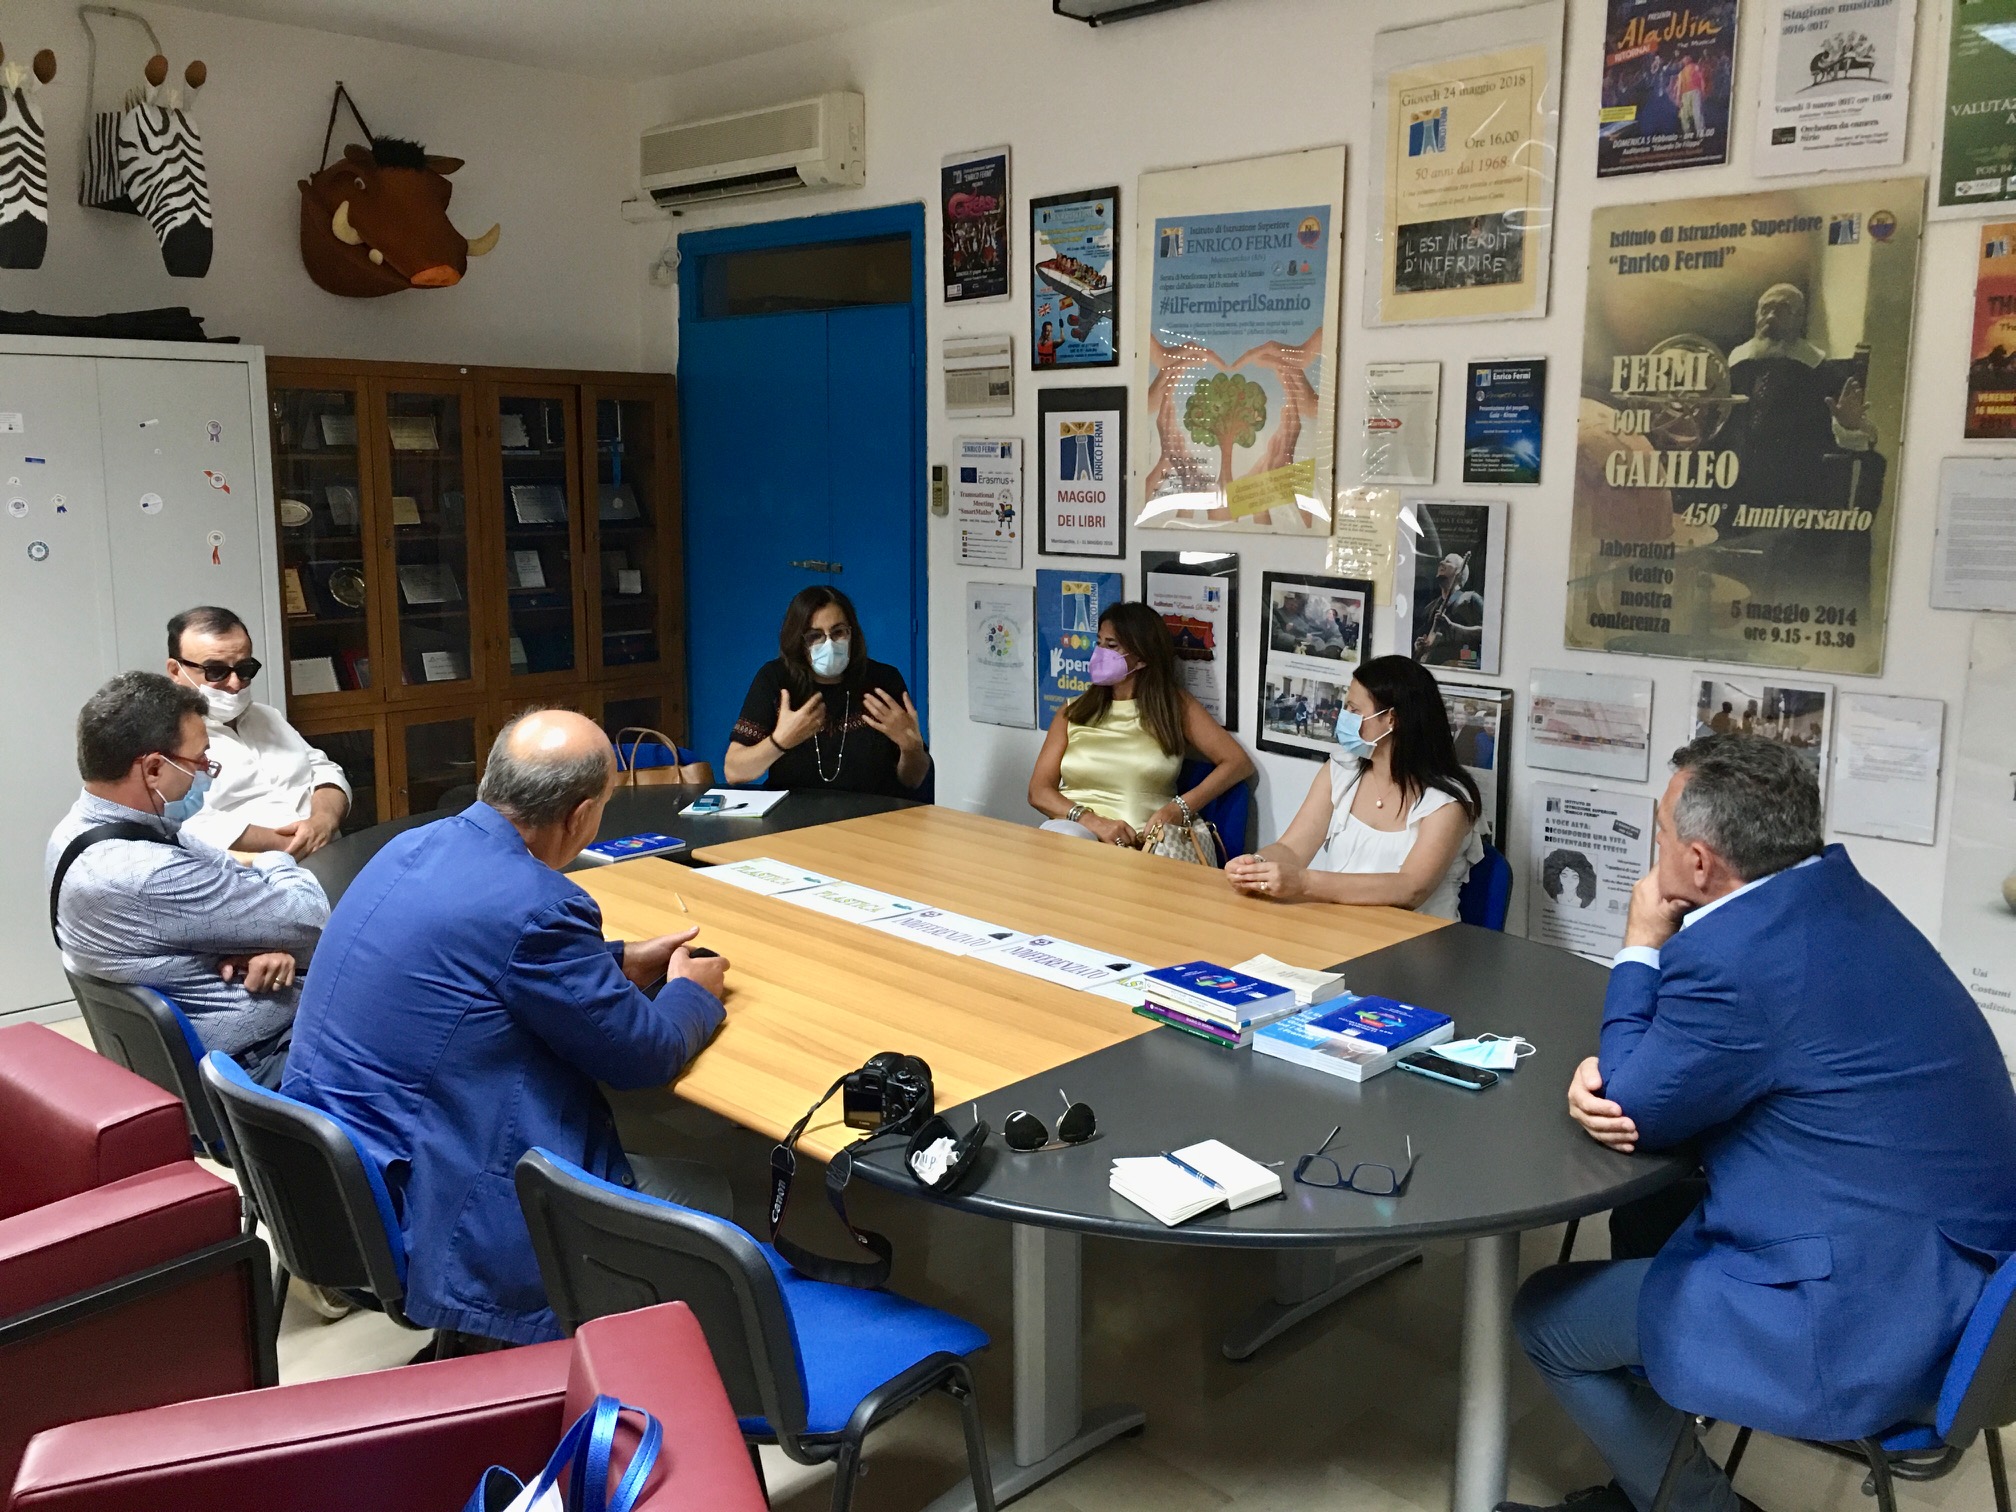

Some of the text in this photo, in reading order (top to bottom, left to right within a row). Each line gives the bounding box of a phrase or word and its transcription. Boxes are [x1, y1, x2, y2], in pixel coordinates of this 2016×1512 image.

[1783, 6, 1834, 20] Stagione
[1617, 9, 1722, 49] Aladdin
[1443, 86, 1456, 99] 24
[1460, 81, 1496, 97] maggio
[1500, 74, 1526, 90] 2018
[1465, 137, 1486, 149] Ore
[1457, 161, 1475, 176] dal
[1190, 220, 1290, 236] Istituto di Istruzione Superiore
[1610, 215, 1824, 249] Istituto di Istruzione Superiore
[1186, 233, 1293, 255] ENRICO FERMI
[1420, 236, 1443, 253] EST
[1609, 246, 1737, 275] “Enrico Fermi”
[1160, 293, 1311, 318] #ilFermiperilSannio
[1492, 373, 1513, 381] Enrico
[1513, 370, 1531, 380] Fermi
[1610, 351, 1710, 393] FERMI
[1609, 409, 1651, 435] con
[1095, 421, 1103, 447] FERMI
[1095, 448, 1103, 481] ENRICO
[1605, 450, 1740, 489] GALILEO
[978, 475, 1015, 485] Erasmus+
[973, 500, 994, 509] Meeting
[1057, 490, 1106, 504] MAGGIO
[1058, 515, 1106, 529] DEI LIBRI
[1732, 504, 1872, 531] Anniversario
[1600, 539, 1675, 560] laboratori
[1629, 565, 1674, 584] teatro
[1620, 590, 1673, 609] mostra
[1590, 611, 1671, 633] conferenza
[1731, 600, 1859, 628] 5 maggio 2014
[1744, 627, 1768, 642] ore
[1771, 628, 1802, 645] 9.15
[1815, 631, 1856, 649] 13.30
[1552, 819, 1570, 827] VOCE
[1609, 836, 1627, 845] VITA
[730, 865, 796, 886] PLASTICA
[812, 890, 886, 913] PLASTICA
[1973, 967, 1988, 979] Usi
[1970, 983, 2012, 999] Costumi
[772, 1179, 787, 1223] Canon
